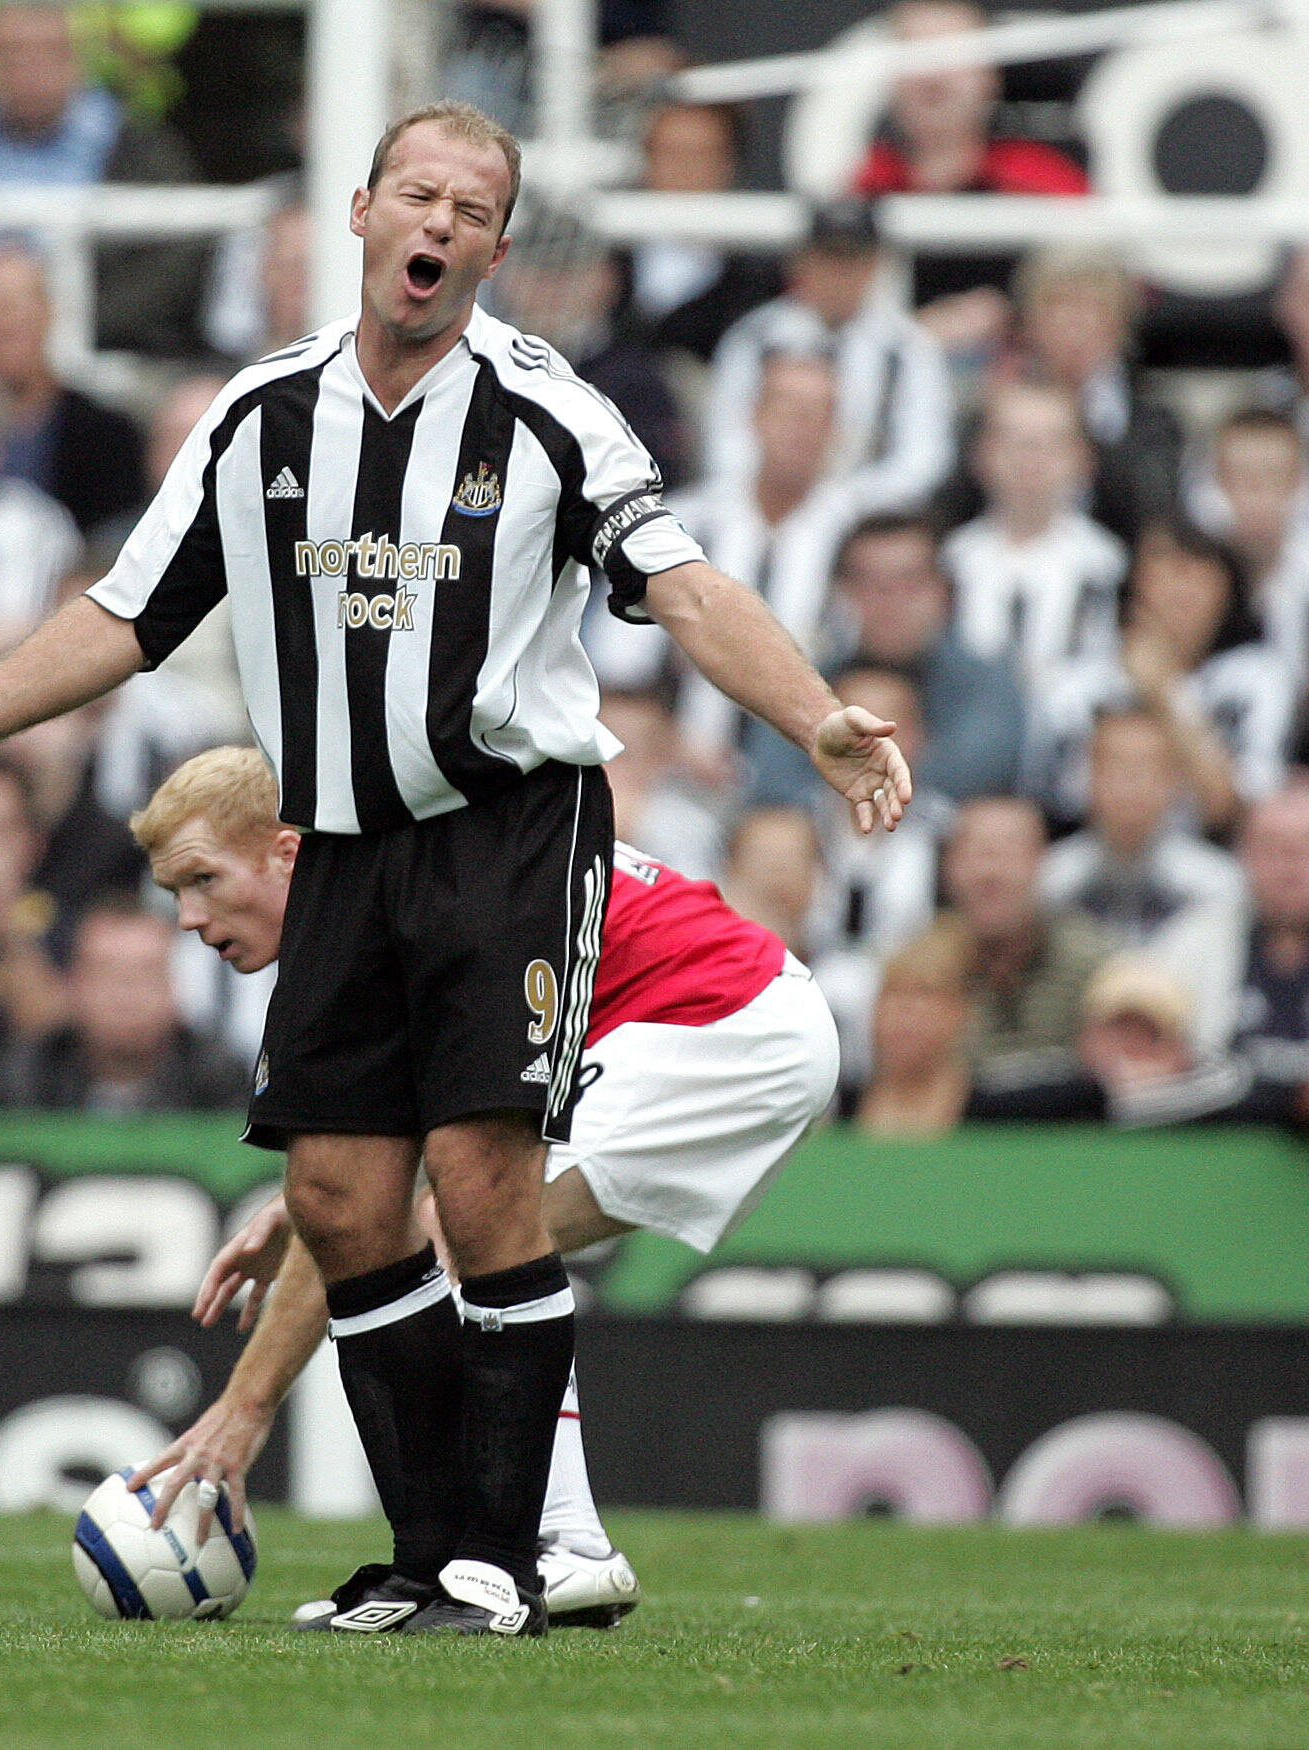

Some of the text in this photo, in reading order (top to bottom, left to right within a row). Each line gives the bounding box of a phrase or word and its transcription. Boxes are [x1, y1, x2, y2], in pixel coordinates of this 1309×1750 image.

[294, 531, 462, 581] northern
[338, 584, 419, 632] rock
[524, 958, 559, 1044] 9
